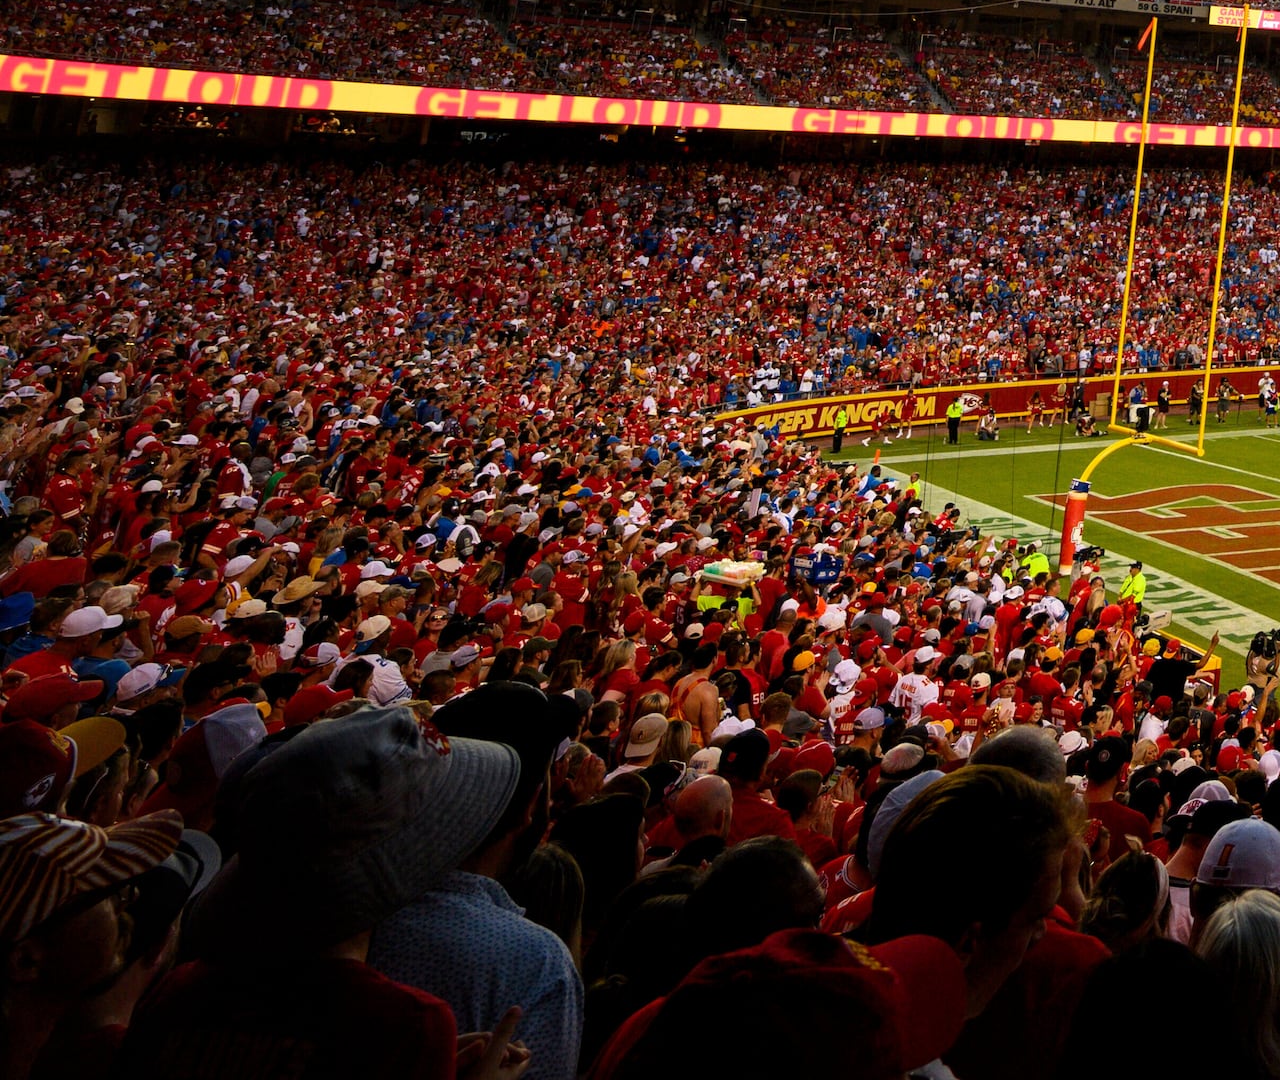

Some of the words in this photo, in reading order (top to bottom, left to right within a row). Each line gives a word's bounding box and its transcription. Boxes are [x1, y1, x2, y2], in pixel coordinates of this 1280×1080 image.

[1138, 2, 1149, 11] 59
[1163, 5, 1193, 15] SPANI
[1220, 8, 1248, 18] GAM
[0, 57, 140, 98] GET
[148, 70, 333, 110] LOUD
[416, 89, 546, 122] GET
[558, 97, 722, 128] LOUD
[793, 109, 903, 136] GET
[916, 114, 1054, 140] LOUD
[1115, 123, 1207, 144] GET
[752, 692, 766, 705] 58
